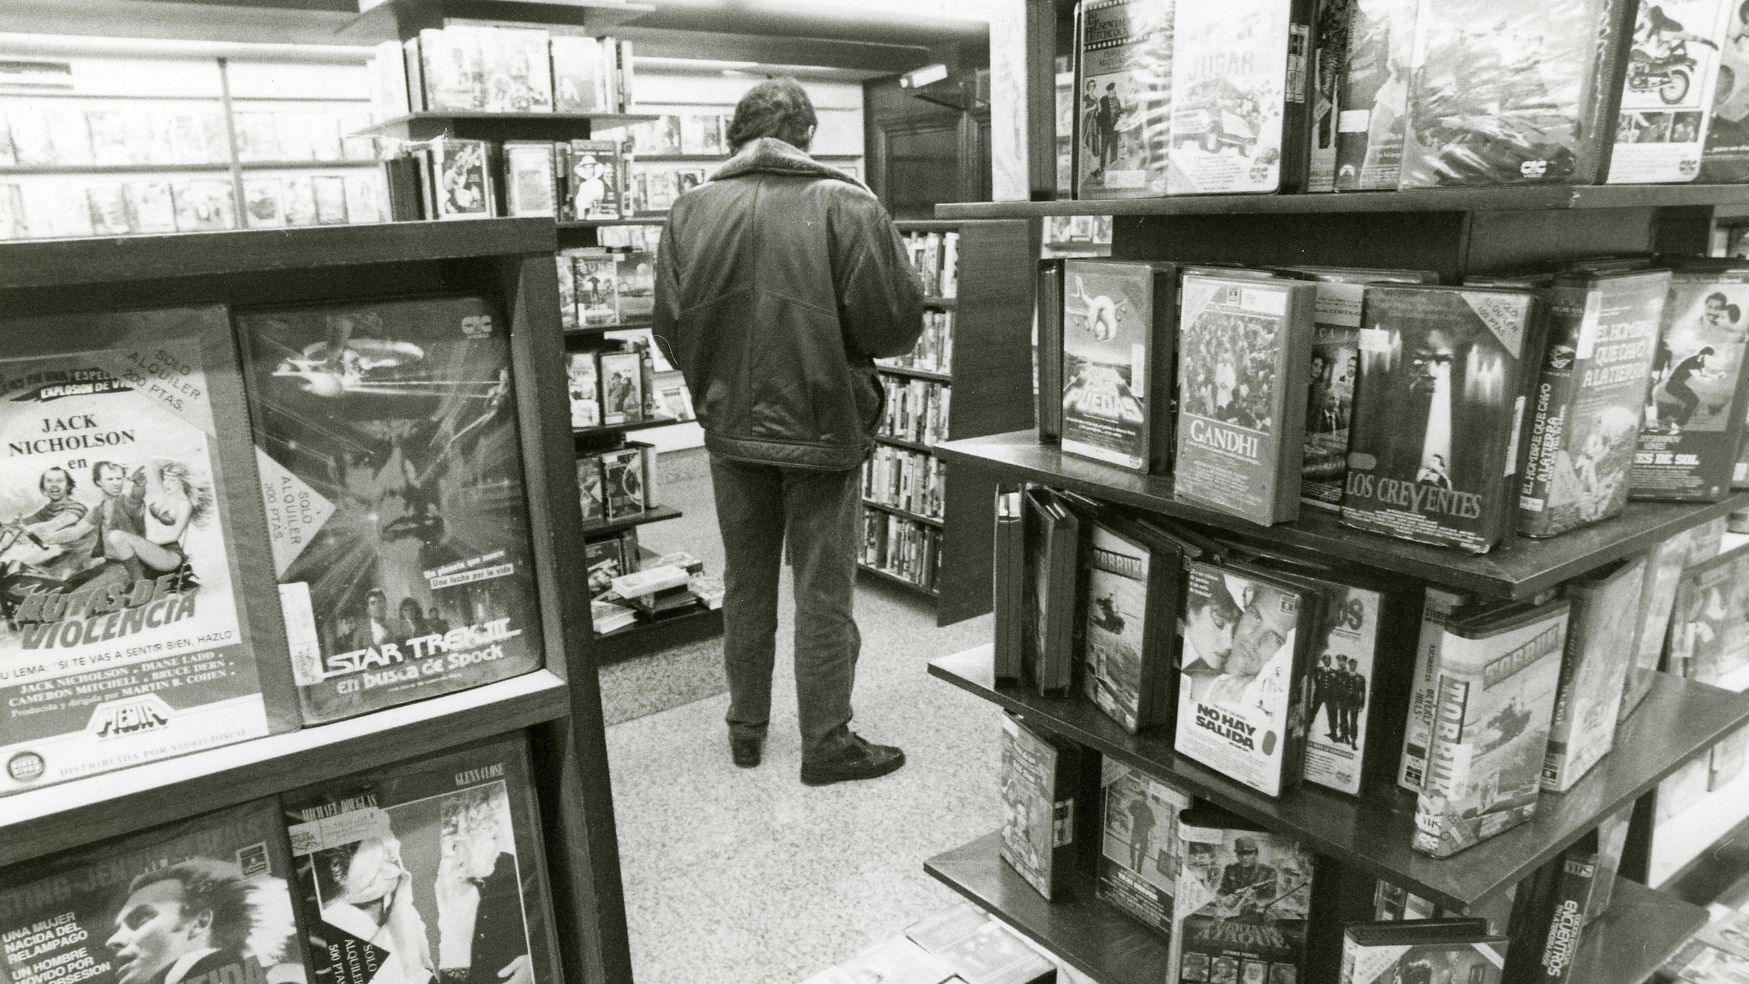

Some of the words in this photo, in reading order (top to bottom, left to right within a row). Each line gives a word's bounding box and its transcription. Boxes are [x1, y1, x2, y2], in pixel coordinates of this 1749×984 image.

[128, 351, 201, 401] ALQUILER
[157, 350, 191, 376] SOLO
[41, 414, 98, 434] JACK
[1190, 419, 1259, 459] GANDHI
[1533, 411, 1547, 435] QUE
[1540, 415, 1560, 457] TIERRA
[8, 429, 136, 457] NICHOLSON
[1524, 435, 1543, 480] HOMBRE
[67, 458, 88, 470] en
[281, 475, 301, 545] ALQUILER
[299, 491, 313, 524] SOLO
[1346, 471, 1374, 498] LOS
[1377, 477, 1483, 519] CREYENTES
[21, 591, 198, 650] VIOLENCIA
[74, 656, 86, 667] TE
[90, 652, 112, 665] VAS
[115, 652, 122, 660] A
[127, 643, 163, 658] SENTIR
[198, 630, 233, 643] HAZLO
[326, 642, 405, 673] STAR
[405, 624, 481, 659] TREK
[8, 689, 72, 707] CAMERON
[75, 676, 140, 695] MITCHELL
[151, 668, 191, 681] BRUCE
[193, 659, 226, 672] DERN
[20, 681, 54, 695] JACK
[57, 667, 130, 686] NICHOLSON
[141, 660, 180, 673] DIANE
[182, 651, 215, 665] LADD
[122, 683, 170, 699] MARTIN
[187, 670, 227, 685] COHEN
[336, 679, 361, 695] en
[363, 664, 420, 689] busca
[421, 658, 445, 675] de
[447, 644, 504, 671] Spock
[1195, 715, 1255, 751] SALIDA
[1197, 703, 1220, 722] NO
[1221, 711, 1257, 738] HAY
[1432, 683, 1465, 795] TOBRUK
[480, 762, 505, 780] CLOSE
[2, 926, 31, 944] UNA
[32, 911, 77, 934] MUJER
[4, 930, 53, 955] NACIDA
[56, 922, 82, 940] DEL
[1548, 901, 1578, 976] ENCUENTROS
[7, 929, 89, 965] RELAMPAGO
[12, 964, 34, 981] UN
[36, 947, 89, 971] HOMBRE
[328, 943, 341, 964] 500
[363, 943, 378, 973] SOLO
[67, 957, 95, 974] POR
